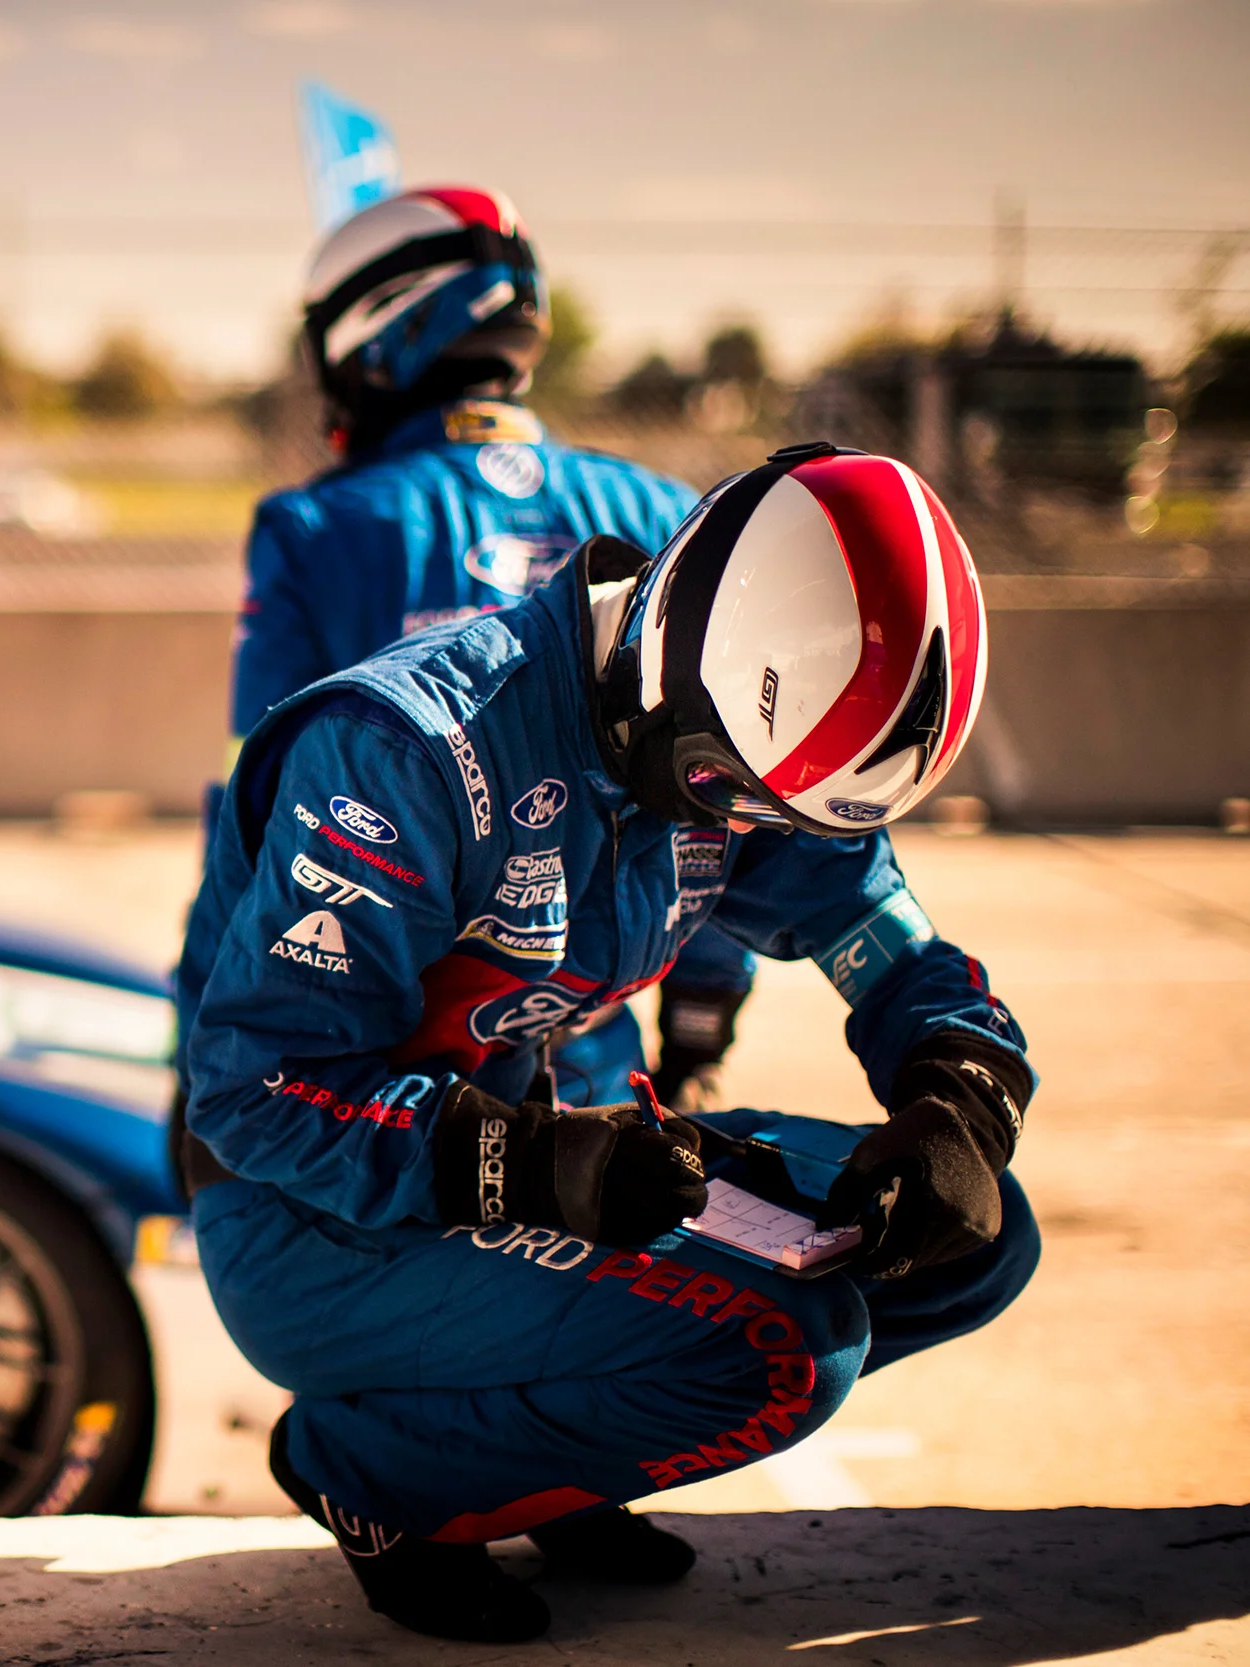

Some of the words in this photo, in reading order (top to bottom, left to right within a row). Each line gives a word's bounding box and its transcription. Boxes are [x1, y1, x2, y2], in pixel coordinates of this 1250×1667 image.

[446, 724, 492, 841] sparco
[528, 785, 558, 825] Ford
[337, 803, 385, 839] Ford
[293, 803, 321, 831] FORD
[318, 824, 424, 888] PERFORMANCE
[291, 853, 393, 908] GT
[269, 940, 350, 974] AXALTA
